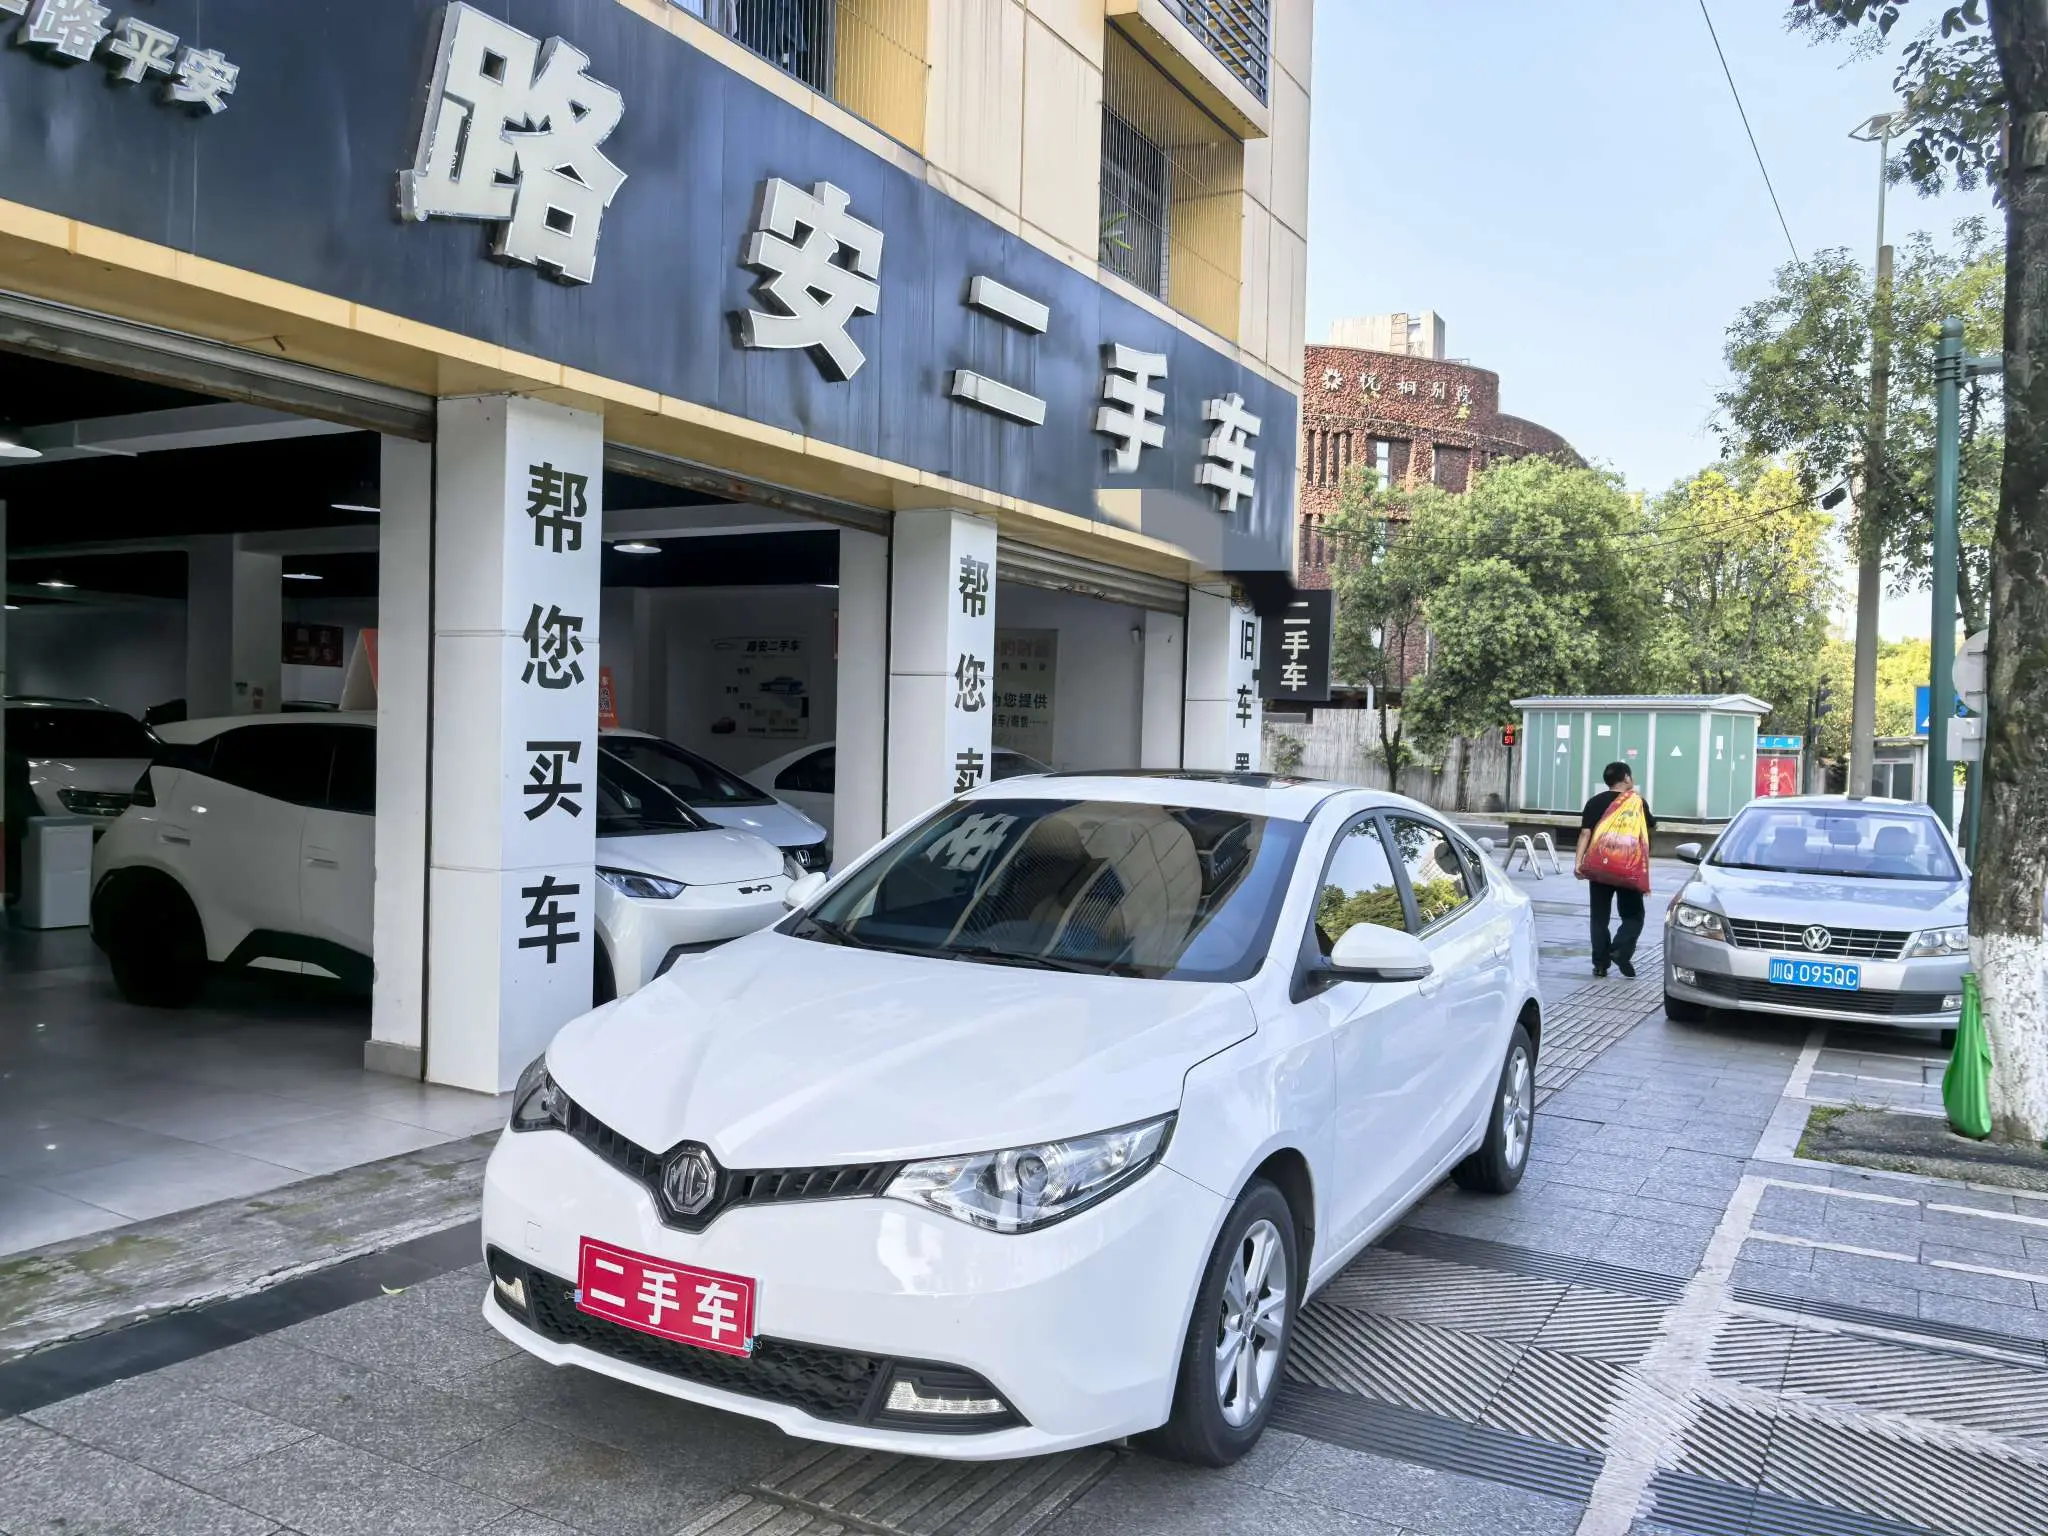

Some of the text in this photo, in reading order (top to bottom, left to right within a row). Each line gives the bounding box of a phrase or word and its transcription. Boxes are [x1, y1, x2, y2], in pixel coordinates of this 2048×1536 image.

[1280, 601, 1311, 692] 二手车
[518, 461, 589, 964] 帮您买车
[666, 1153, 712, 1208] MG
[590, 1258, 739, 1340] 二手车
